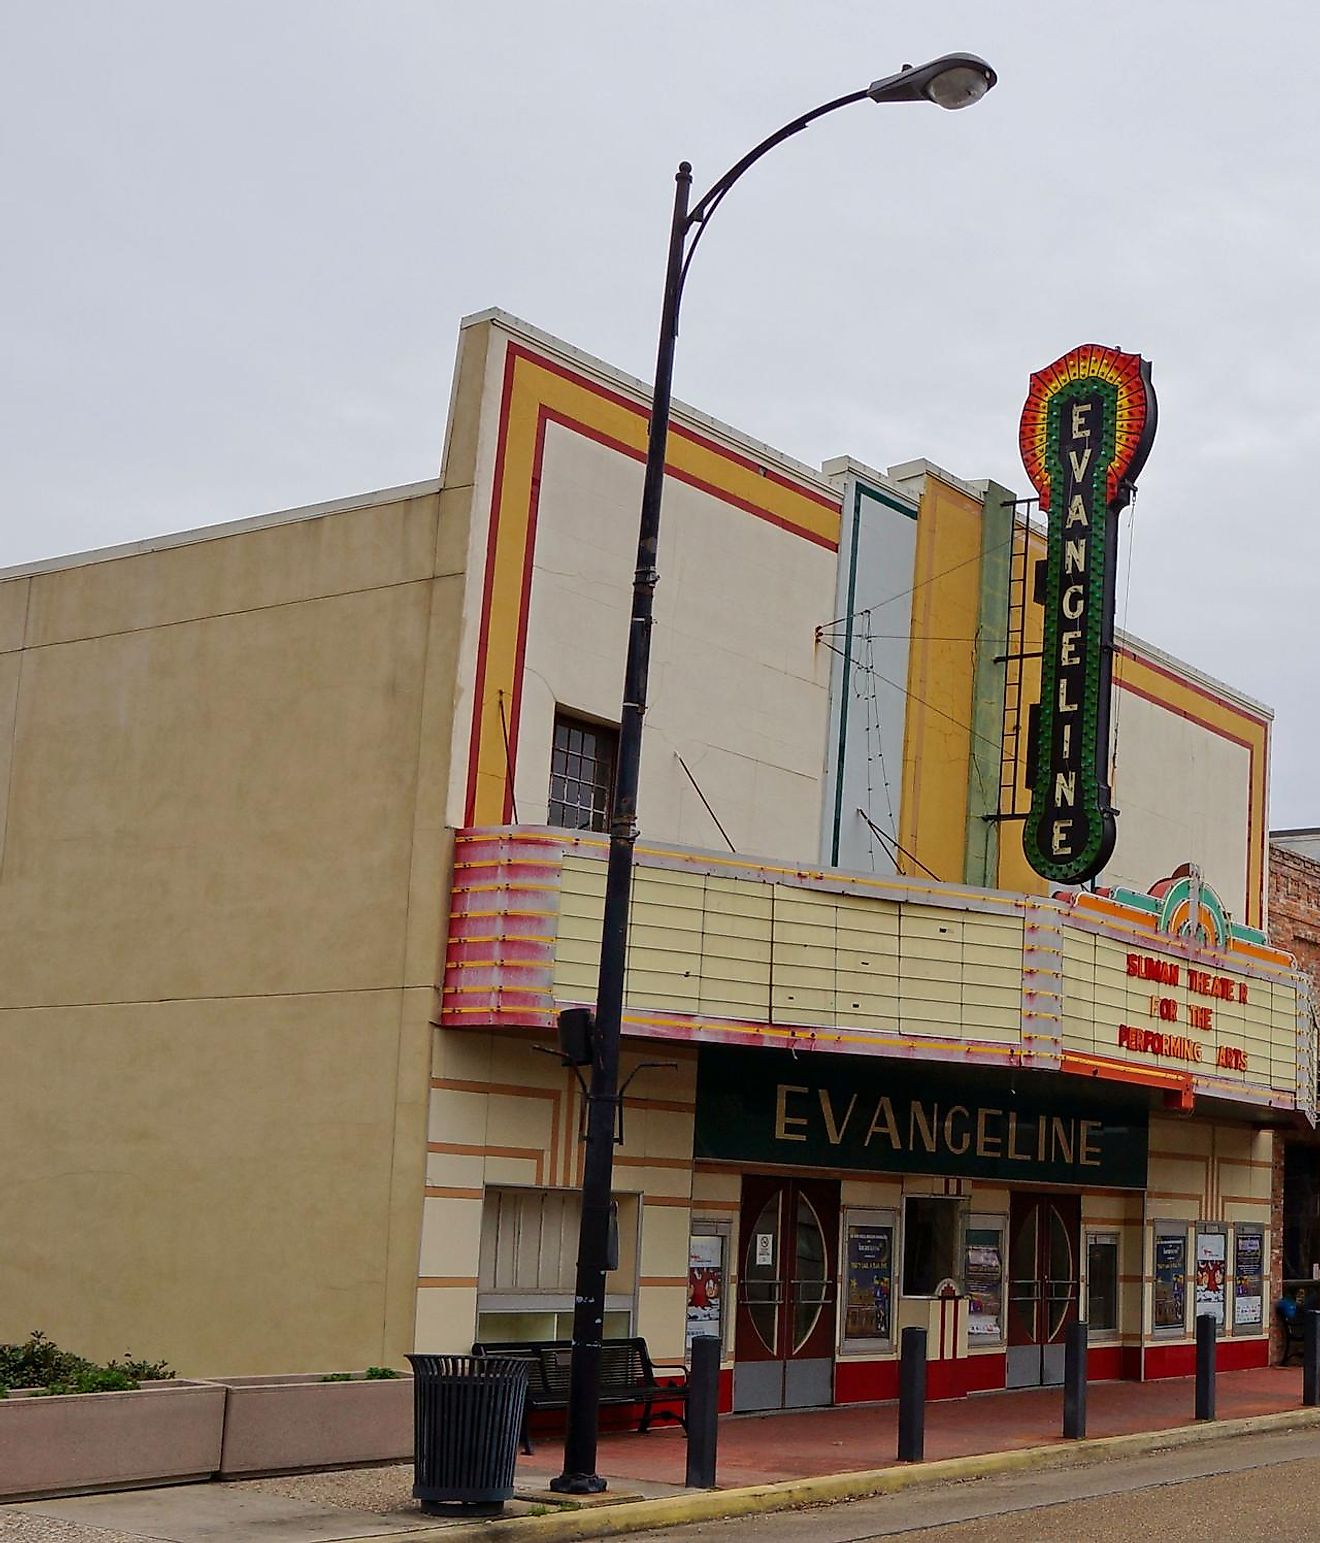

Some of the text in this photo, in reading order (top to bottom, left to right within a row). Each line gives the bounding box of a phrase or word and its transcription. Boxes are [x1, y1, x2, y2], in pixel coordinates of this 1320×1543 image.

[1052, 404, 1092, 856] EVANGELINE
[1126, 953, 1180, 986] SLIMAN
[1150, 994, 1213, 1030] FOR THE
[1118, 1024, 1249, 1071] PERFORMING ARTS
[775, 1084, 1103, 1166] EVANGELINE
